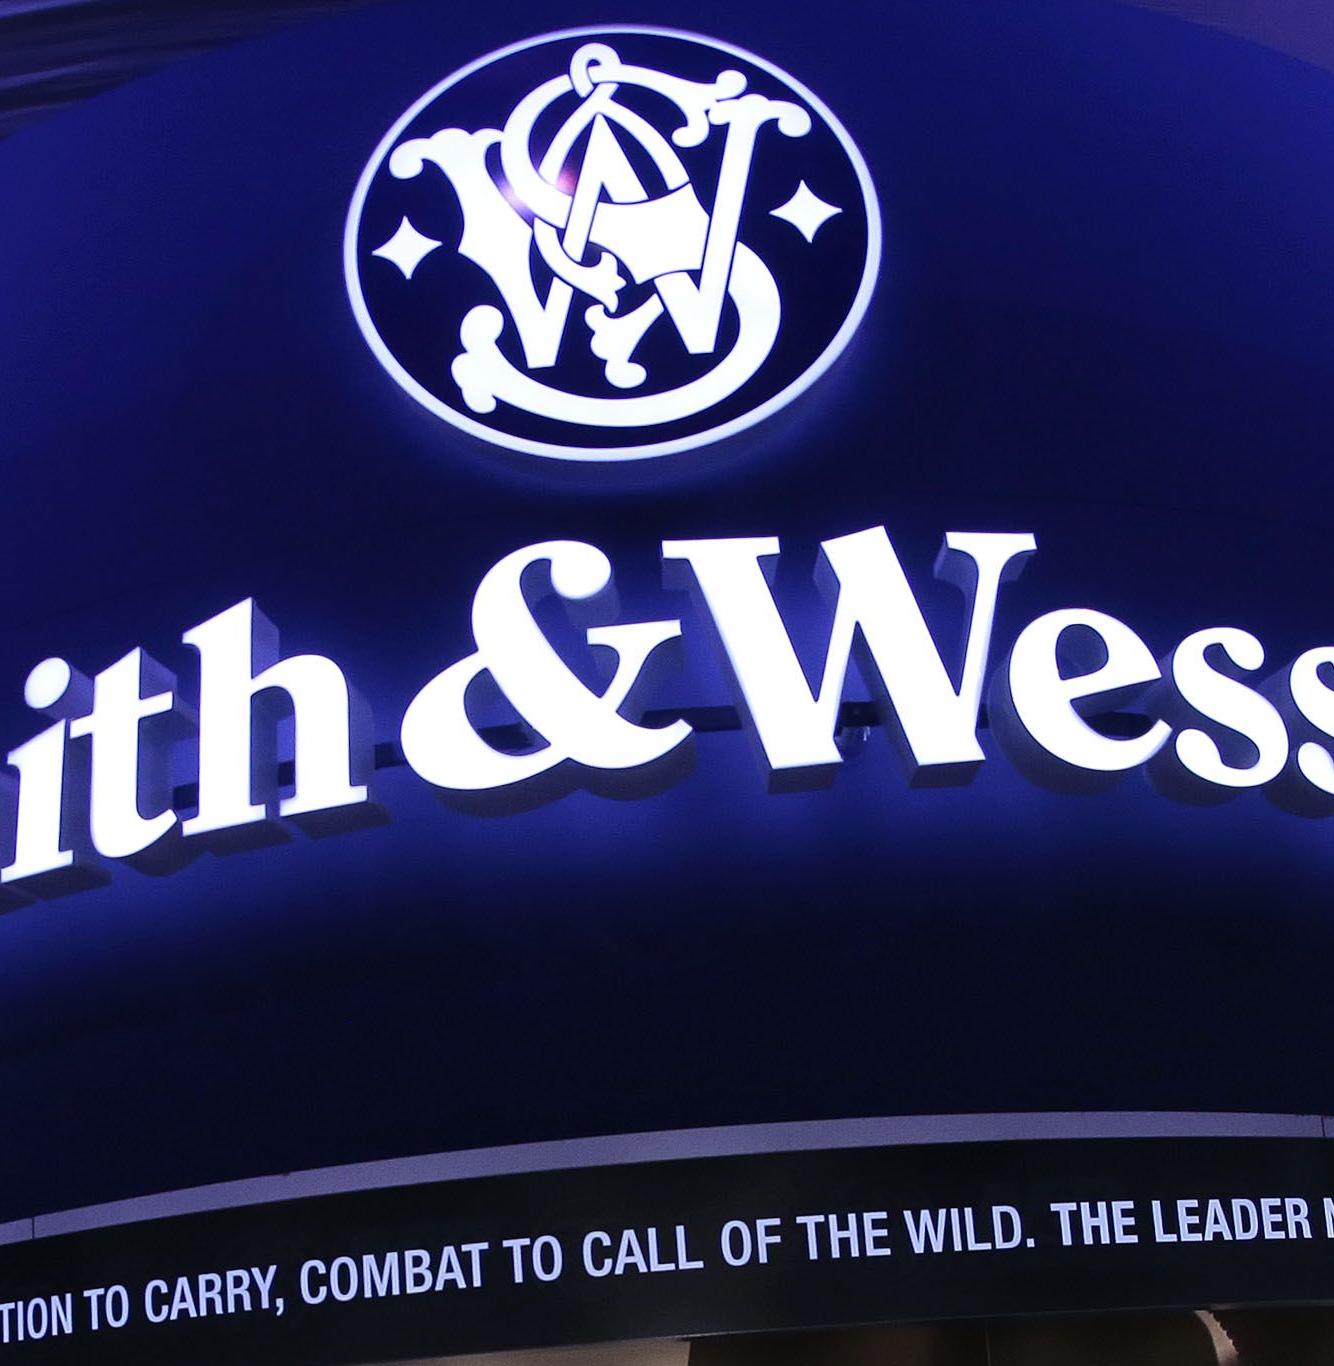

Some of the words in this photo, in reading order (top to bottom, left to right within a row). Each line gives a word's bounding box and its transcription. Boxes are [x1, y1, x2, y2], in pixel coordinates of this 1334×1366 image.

[83, 1285, 130, 1331] TO
[143, 1264, 284, 1324] CARRY,
[299, 1241, 489, 1305] COMBAT
[502, 1234, 564, 1284] TO
[582, 1224, 705, 1279] CALL
[720, 1217, 783, 1268] OF
[796, 1210, 892, 1261] THE
[903, 1203, 1035, 1257] WILD.
[1050, 1200, 1139, 1247] THE
[1151, 1196, 1310, 1243] LEADER
